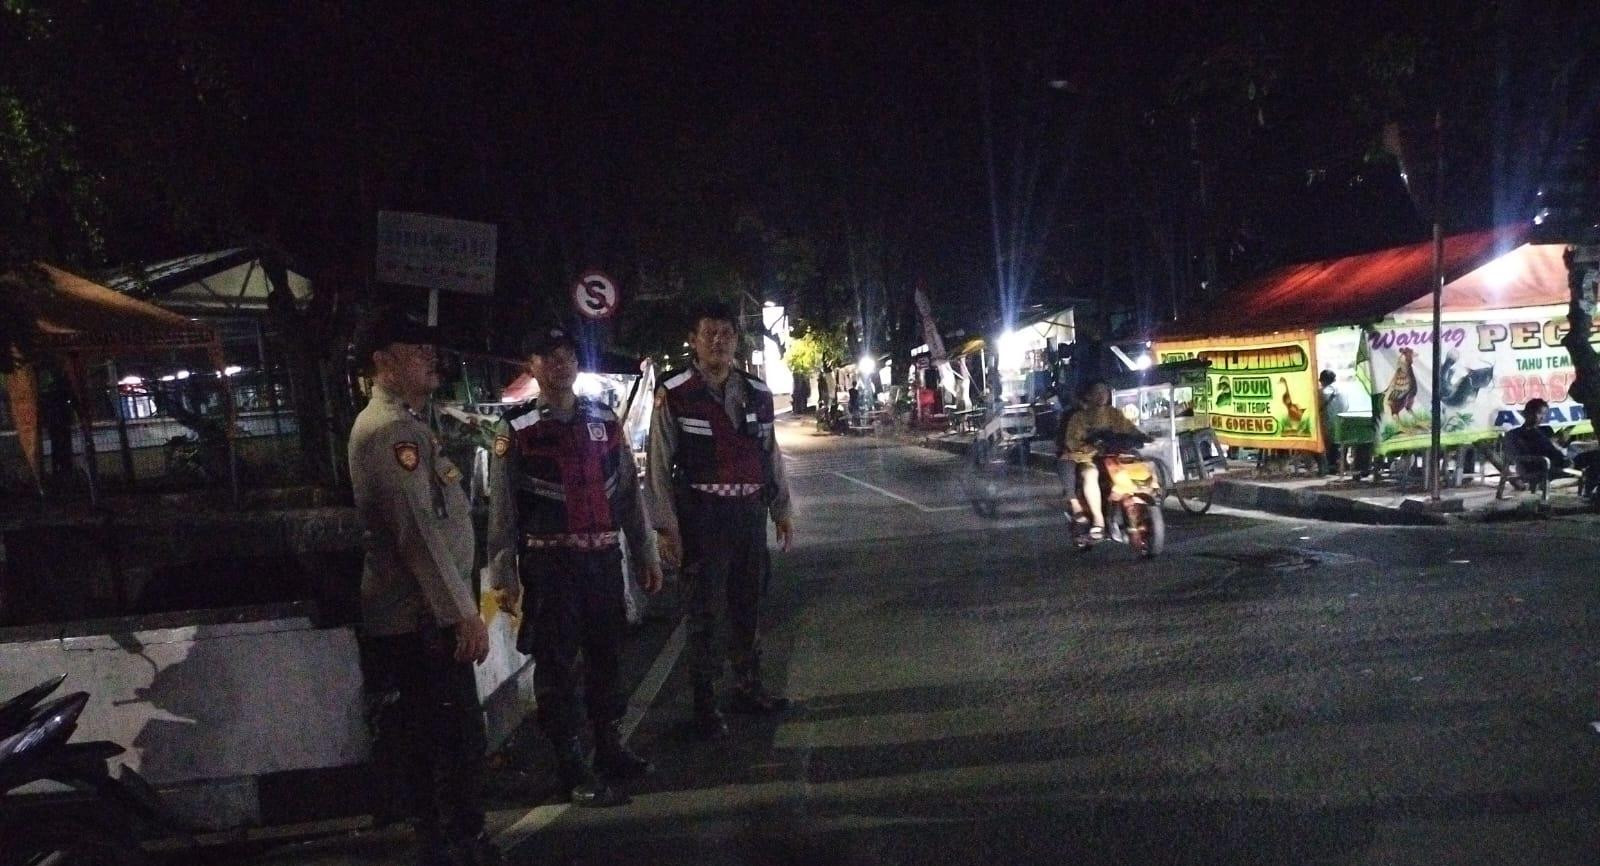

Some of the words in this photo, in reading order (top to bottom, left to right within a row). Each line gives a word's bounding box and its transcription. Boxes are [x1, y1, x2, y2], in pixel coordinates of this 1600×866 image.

[585, 281, 606, 309] S
[1515, 356, 1543, 371] TAHU
[1546, 355, 1571, 369] TEM
[1234, 379, 1269, 395] UDUK
[1248, 401, 1272, 414] TEMPE
[1225, 417, 1274, 431] GORENG
